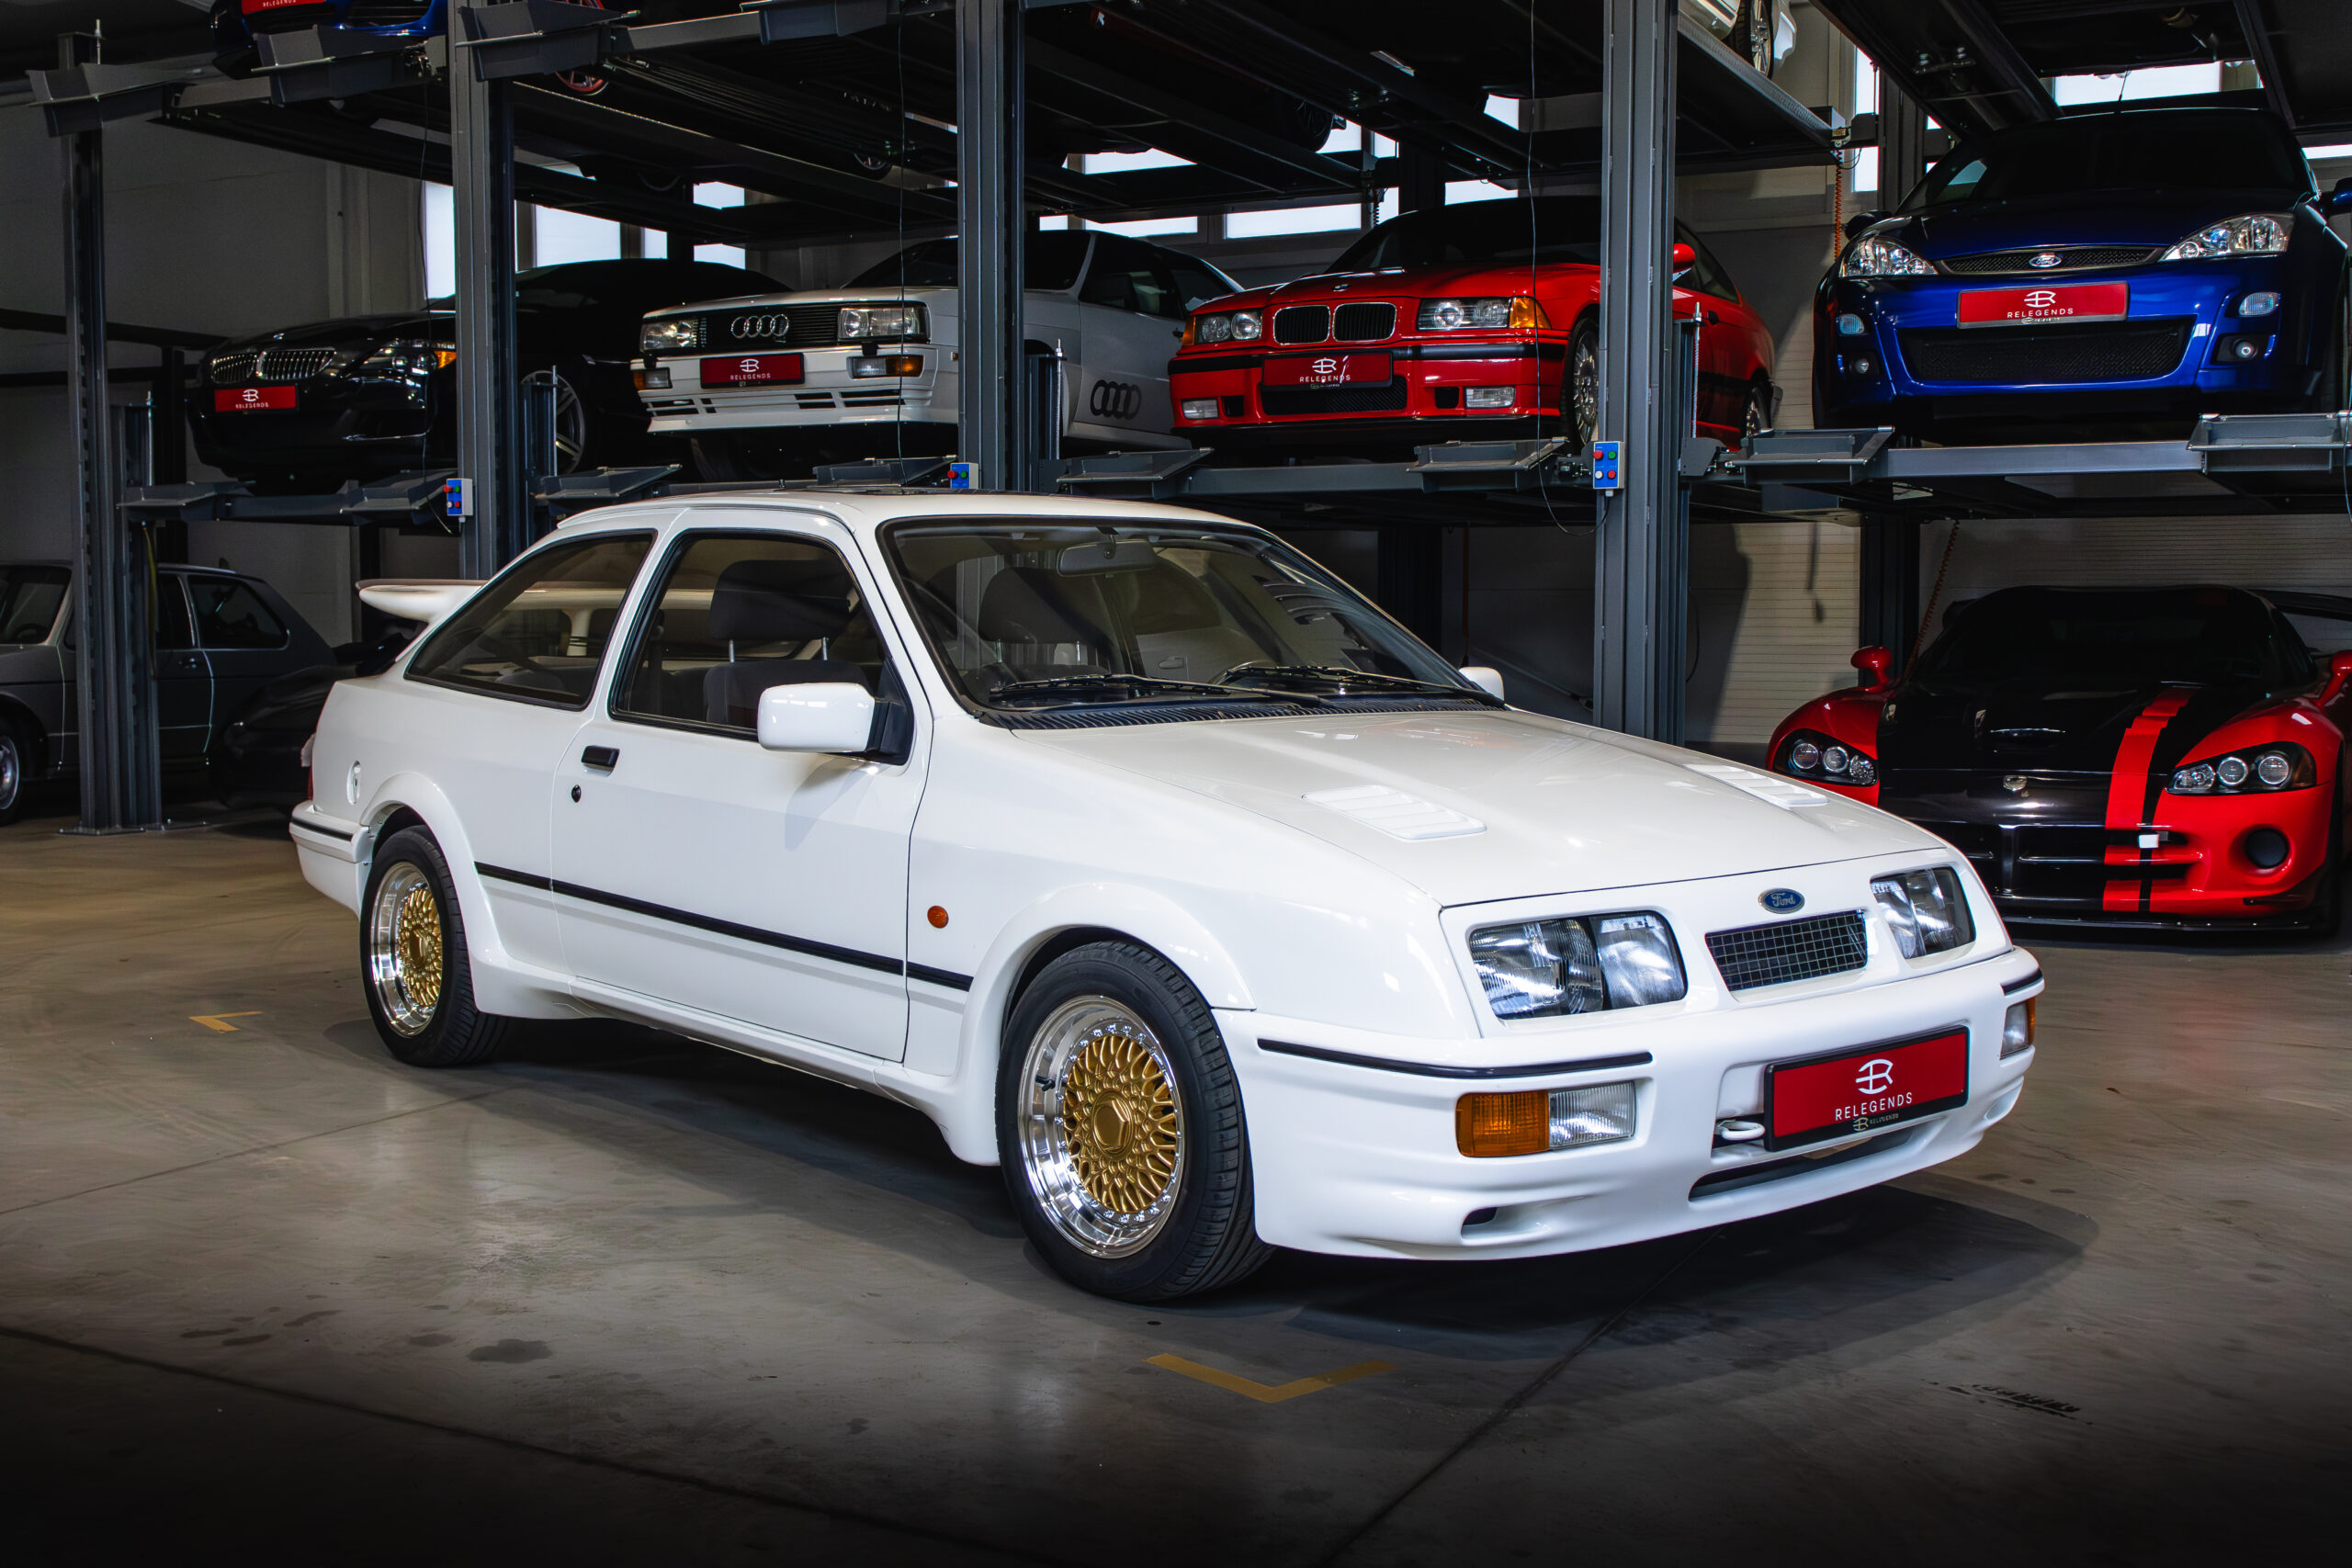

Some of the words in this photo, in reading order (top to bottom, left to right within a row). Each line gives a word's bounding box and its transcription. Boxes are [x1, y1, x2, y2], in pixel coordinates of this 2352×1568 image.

[2007, 308, 2074, 319] RELEGENDS
[729, 372, 772, 380] RELEGENDS
[1299, 374, 1351, 383] RELEGENDS
[1770, 892, 1796, 908] Ford
[1834, 1091, 1914, 1122] RELEGENDS
